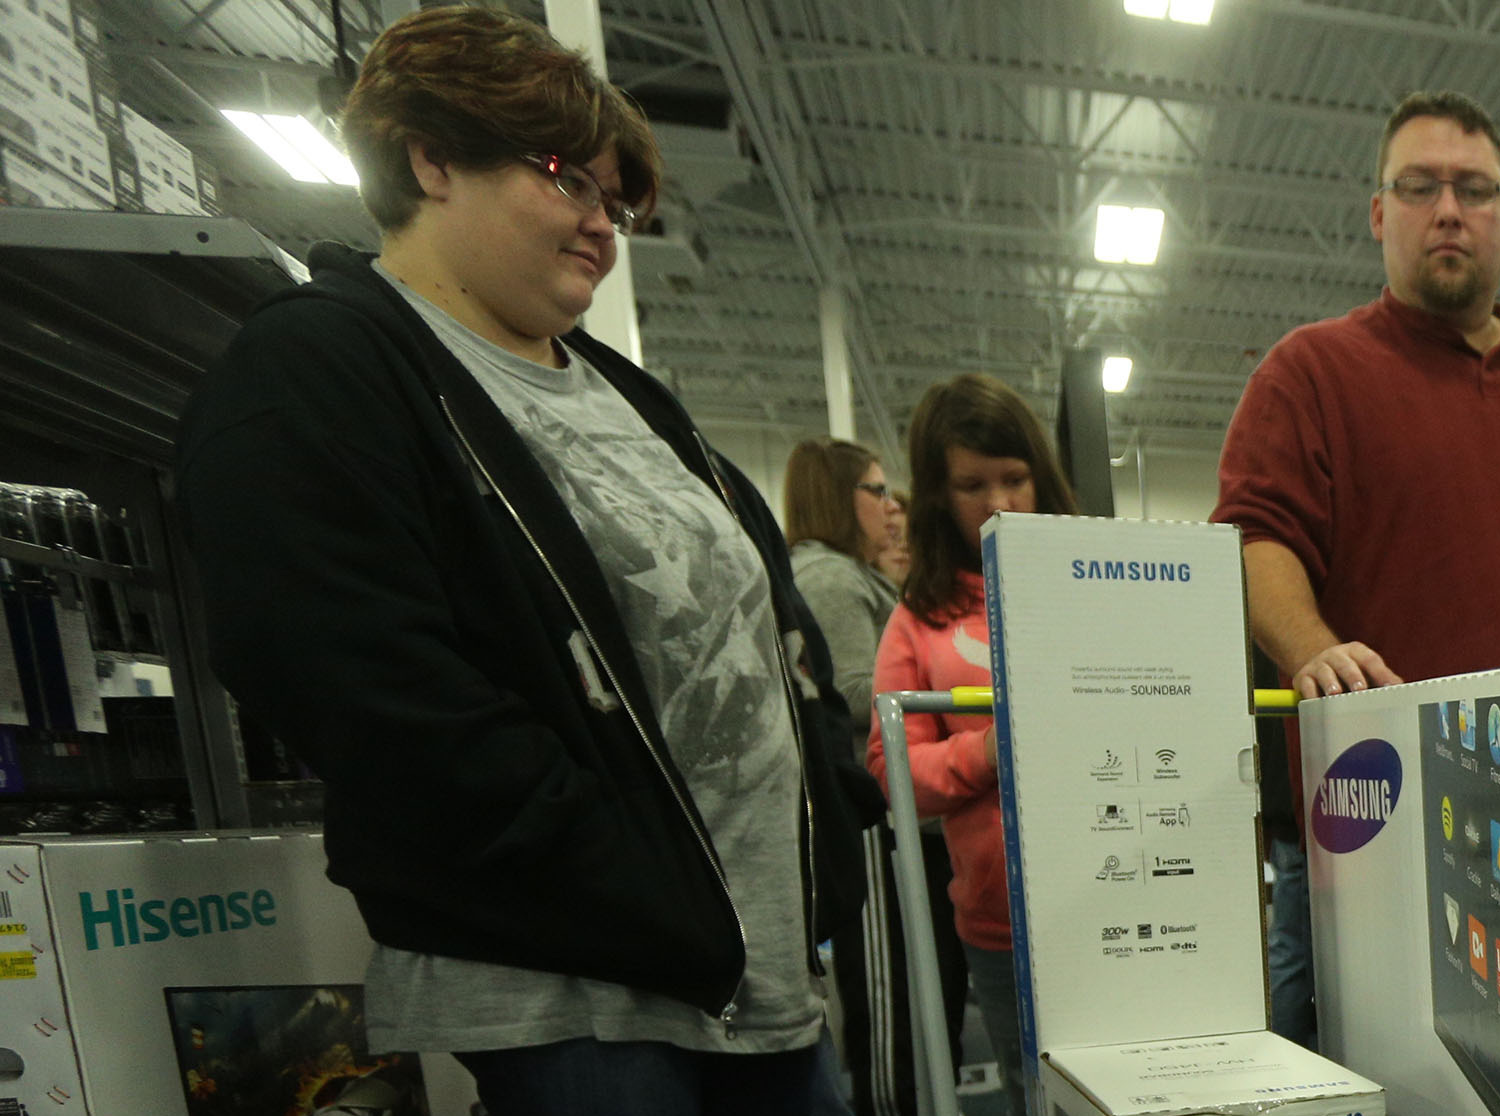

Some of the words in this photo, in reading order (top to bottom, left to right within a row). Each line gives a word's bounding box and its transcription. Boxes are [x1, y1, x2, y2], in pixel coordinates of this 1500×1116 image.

[1071, 559, 1191, 583] SAMSUNG
[1130, 684, 1192, 696] SOUNDBAR
[1320, 778, 1391, 822] SAMSUNG
[1160, 817, 1177, 827] App
[79, 888, 276, 951] Hisense
[1255, 1080, 1351, 1094] SAMSUNG
